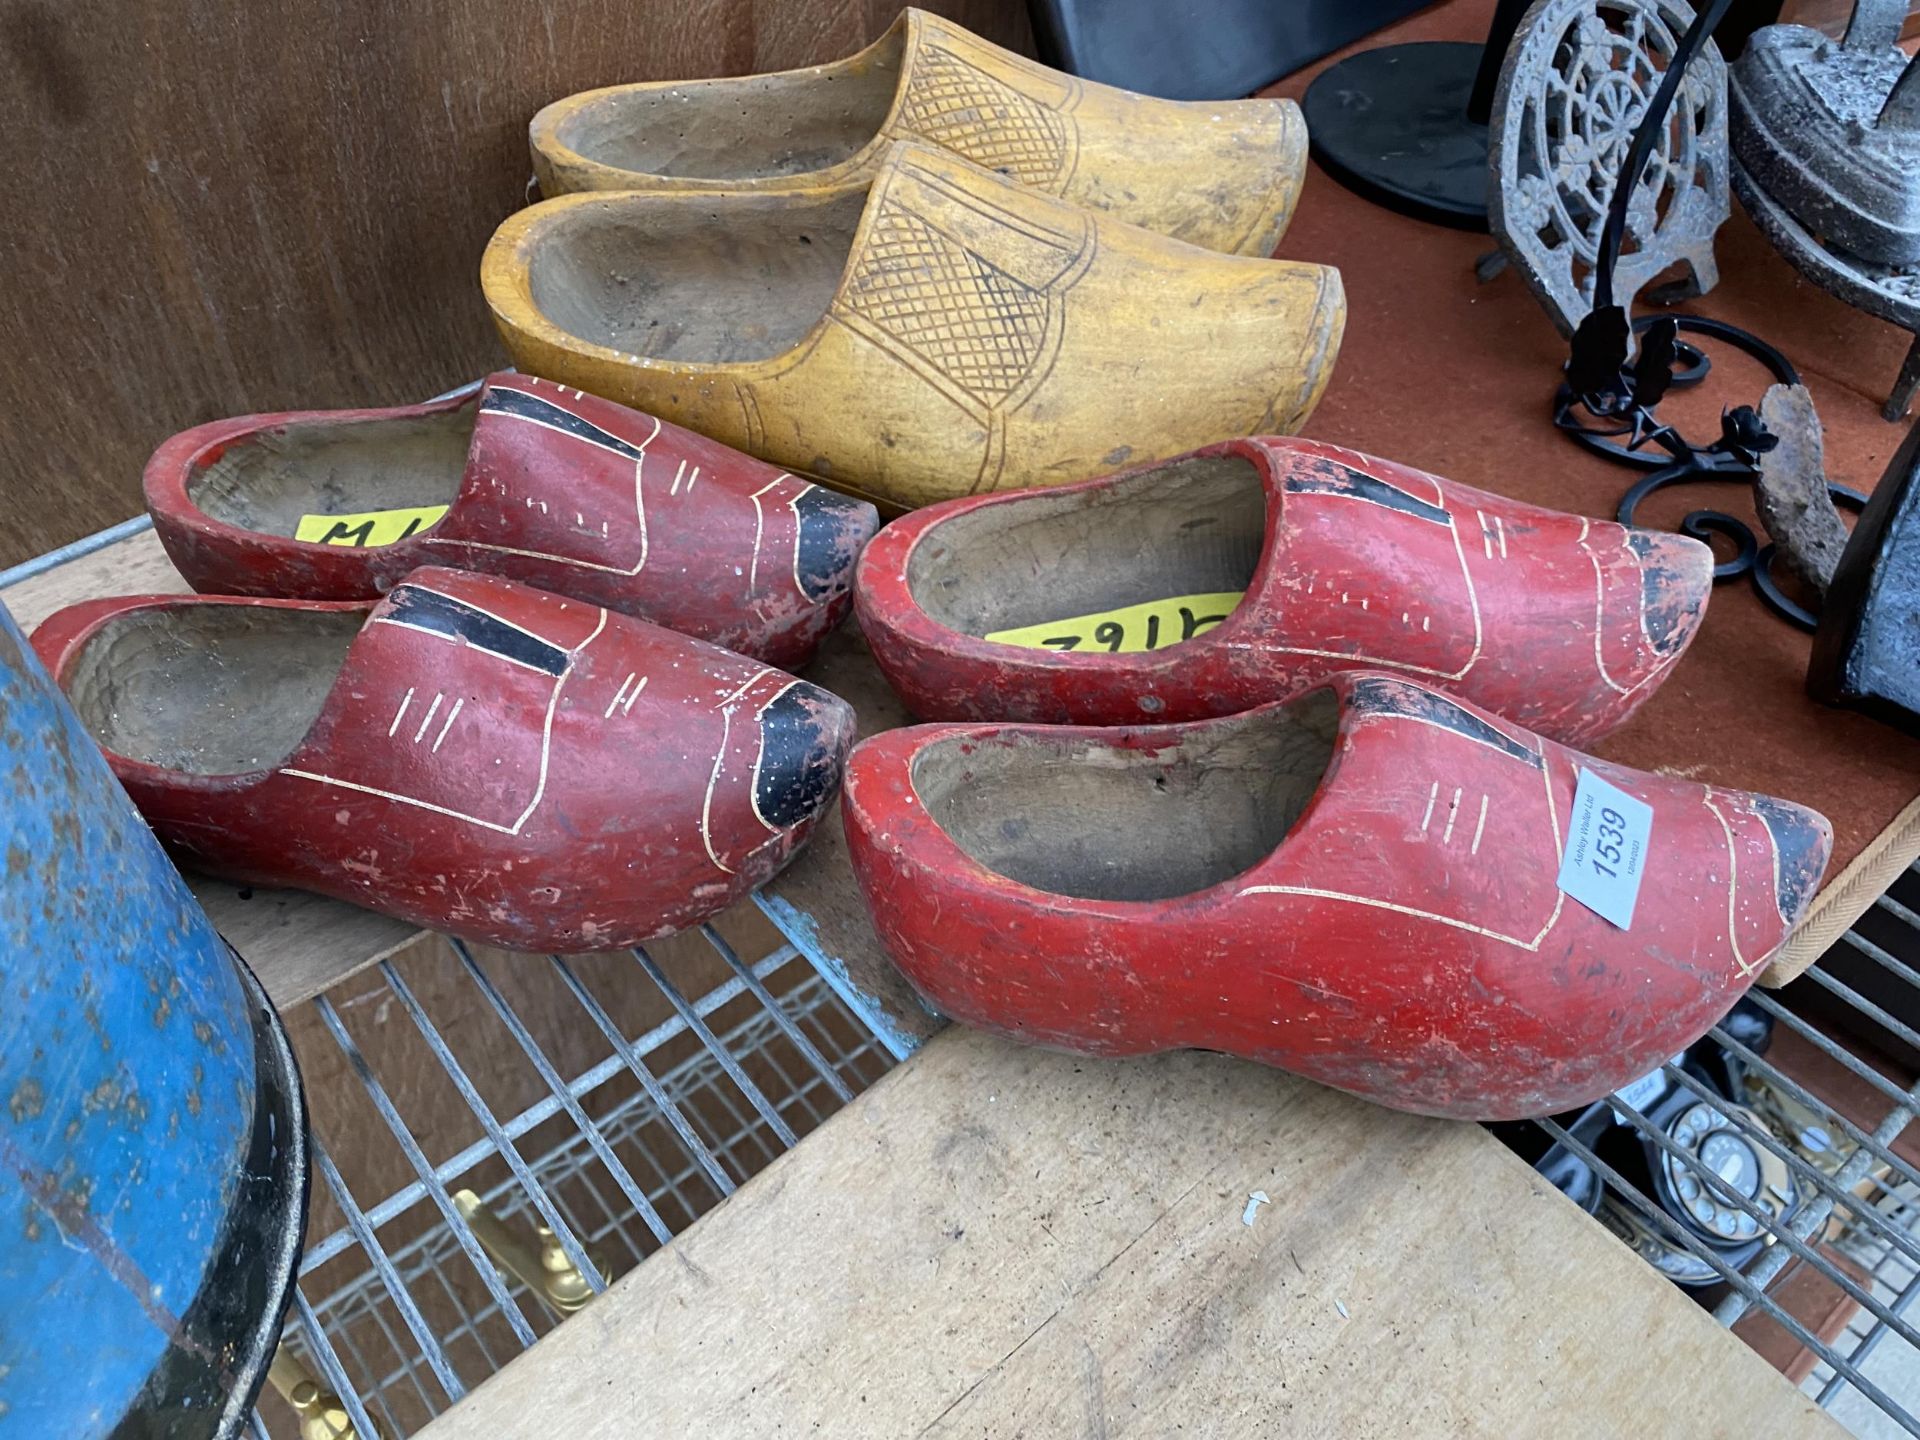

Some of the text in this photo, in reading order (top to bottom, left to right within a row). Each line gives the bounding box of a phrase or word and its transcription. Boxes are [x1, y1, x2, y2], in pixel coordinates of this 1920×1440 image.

[1574, 795, 1594, 867] Ashley Waller Ltd
[1593, 808, 1627, 878] 1539
